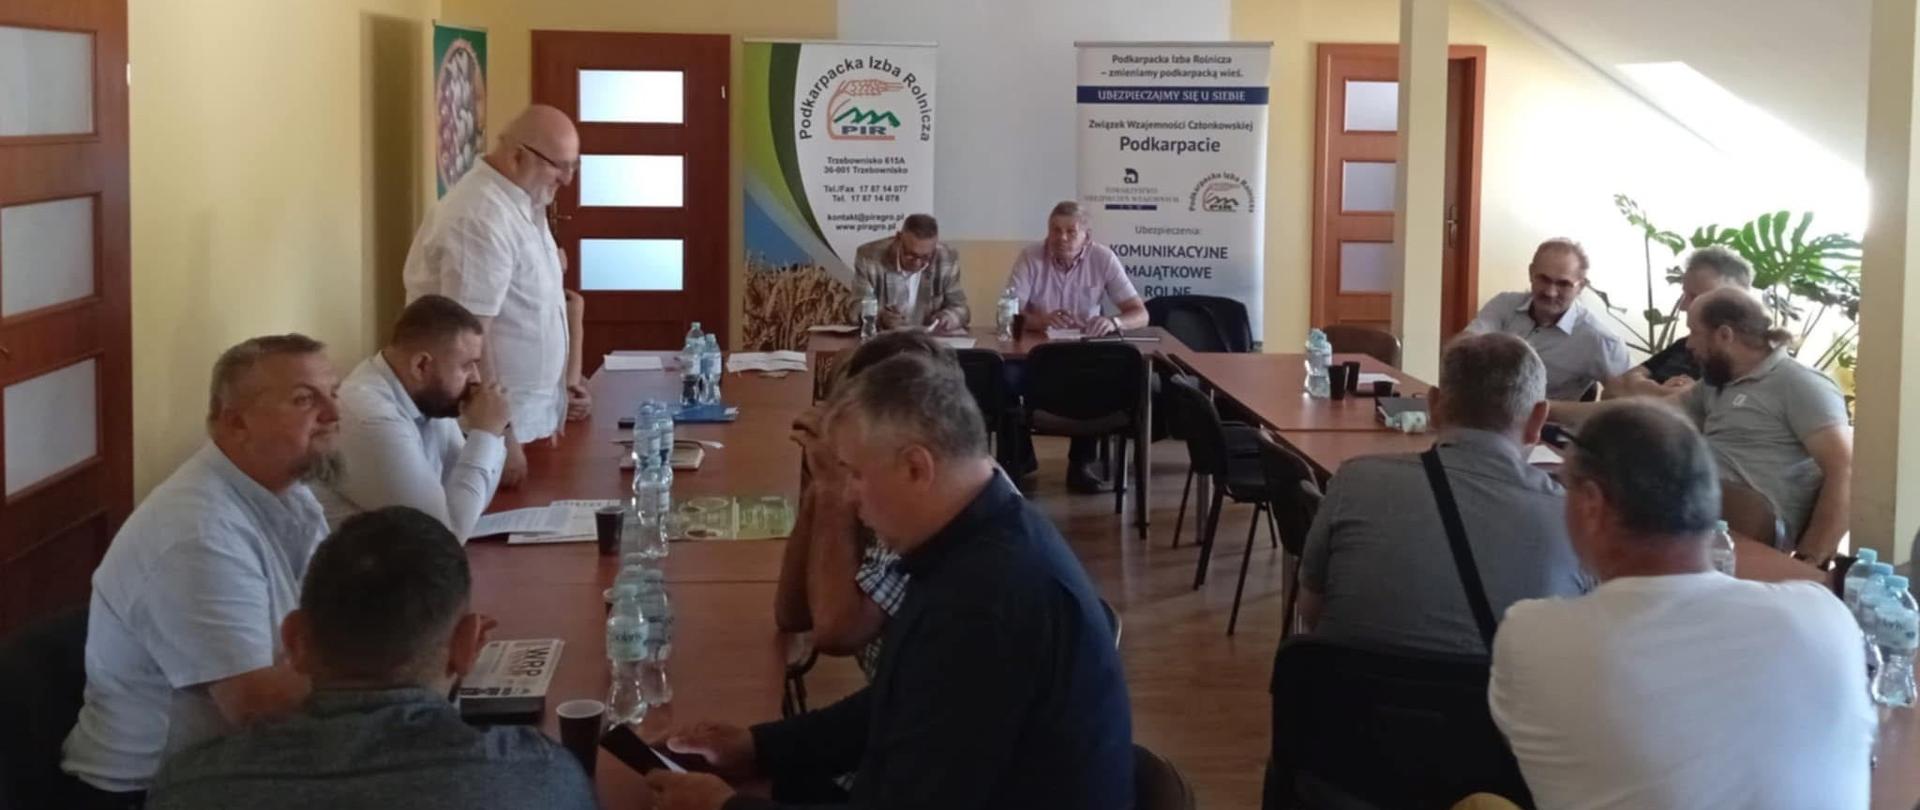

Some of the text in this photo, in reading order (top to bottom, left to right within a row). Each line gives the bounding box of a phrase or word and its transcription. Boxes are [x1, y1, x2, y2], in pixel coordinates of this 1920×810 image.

[1112, 54, 1232, 64] Podkarpacka Izba Rolnicza
[1108, 69, 1157, 78] zmieniamy
[1159, 68, 1218, 79] podkarpacką
[799, 56, 933, 142] Podkarpacka Izba Rolnicza
[1098, 90, 1246, 102] UBEZPIECZAJMY SIĘ U SIEBIE
[841, 125, 887, 135] PIR
[1089, 120, 1125, 131] Związek
[1126, 120, 1185, 131] Wzajemności
[1120, 136, 1221, 155] Podkarpacie
[1109, 243, 1228, 259] KOMUNIKACYJNE
[1126, 265, 1212, 281] MAJĄTKOWE
[1144, 285, 1192, 297] ROLNE
